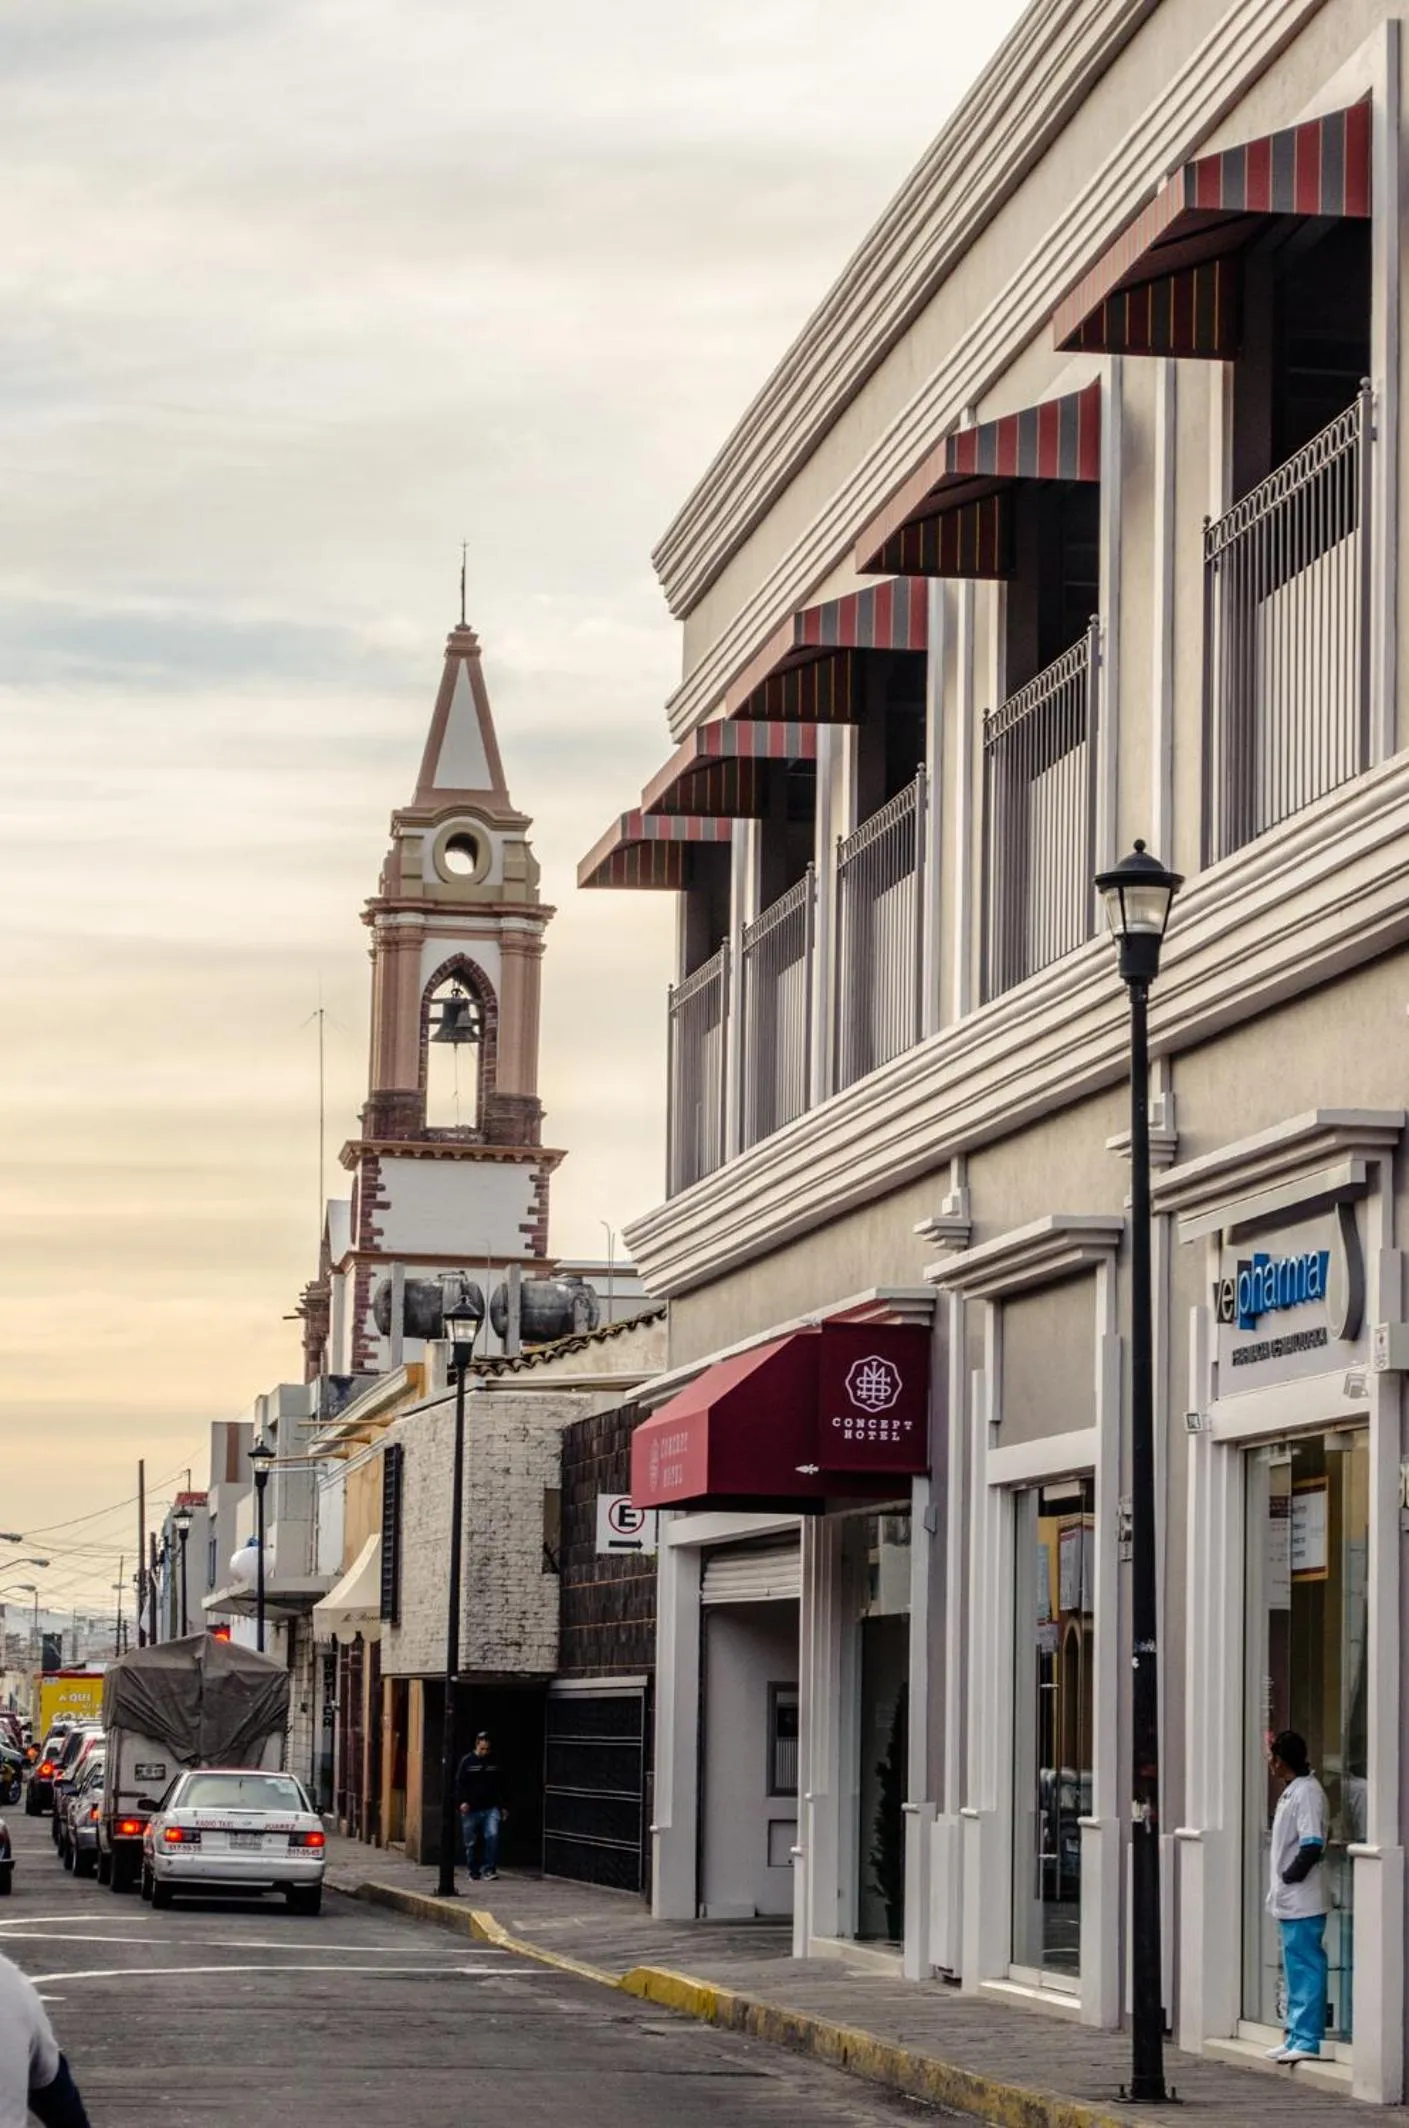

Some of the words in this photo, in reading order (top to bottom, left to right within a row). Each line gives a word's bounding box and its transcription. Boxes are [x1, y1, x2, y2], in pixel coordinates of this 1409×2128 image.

[832, 1417, 912, 1430] CONCEPT
[844, 1429, 900, 1441] HOTEL
[618, 1505, 637, 1527] E
